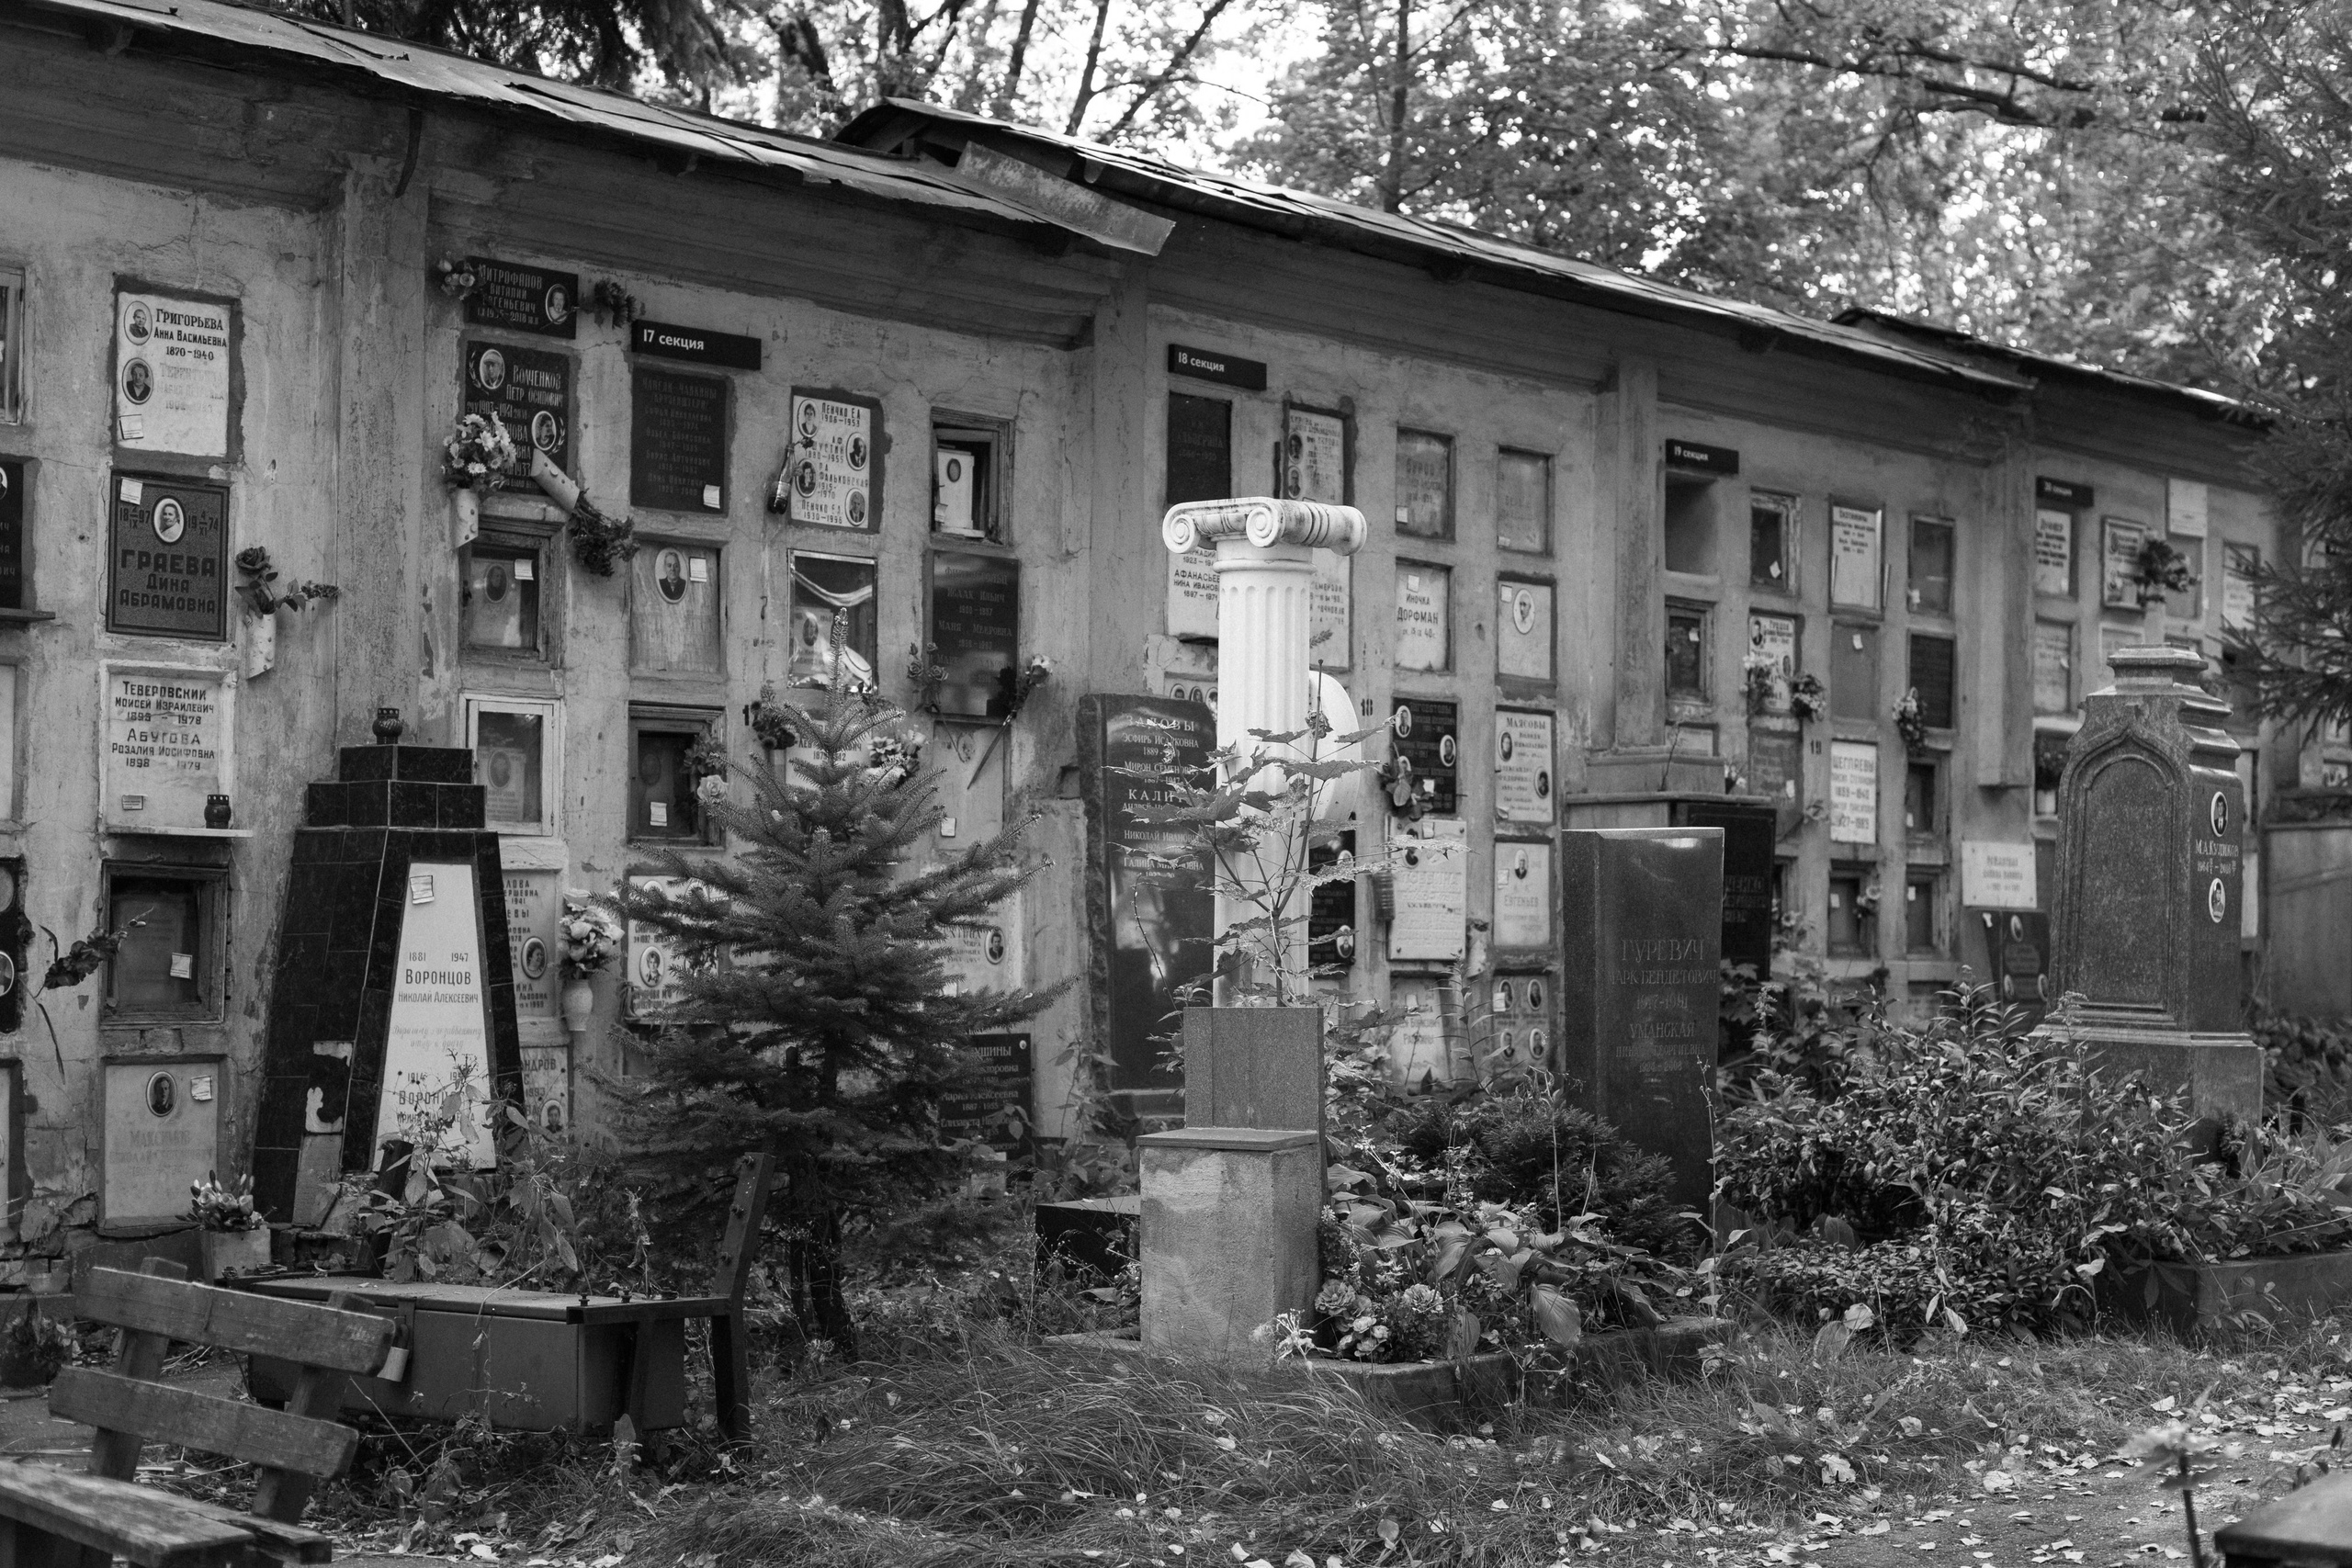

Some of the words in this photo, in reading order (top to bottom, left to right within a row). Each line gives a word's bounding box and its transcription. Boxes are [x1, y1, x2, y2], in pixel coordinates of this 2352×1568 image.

[479, 265, 543, 290] МИТРОФАНОВ
[490, 282, 527, 299] ВИТАЛИЙ
[155, 309, 223, 331] ГРИГОРЬЕВА
[153, 327, 174, 341] АННА
[176, 330, 227, 347] ВАСИЛЬЕВНА
[644, 329, 655, 343] 17
[658, 334, 705, 350] секция
[1178, 352, 1188, 365] 18
[1190, 356, 1225, 372] секция
[513, 365, 561, 390] ВОЛЧЕНКОВ
[506, 384, 525, 401] ПЕТР
[121, 548, 216, 577] ГРАЕВА
[147, 573, 189, 593] ДИНА
[1173, 579, 1191, 588] НИНА
[119, 589, 215, 614] АБРАМОВНА
[1406, 593, 1430, 605] ИНОЧКА
[1396, 606, 1439, 625] ДОРФМАН
[115, 696, 152, 710] МОИСЕЙ
[155, 699, 214, 714] ИЗРАИЛЕВИЧ
[1361, 698, 1374, 716] 18
[127, 728, 200, 745] АБУГОВА
[1122, 733, 1152, 744] ЭСФИРЬ
[111, 742, 155, 756] РОЗАЛИЯ
[159, 746, 215, 760] ИОСИФОВНА
[126, 758, 150, 768] 1898
[1124, 829, 1159, 841] НИКОЛАЙ
[409, 952, 426, 962] 1881
[451, 953, 469, 962] 1947
[1620, 939, 1704, 963] ГУРЕВИЧ
[405, 969, 471, 987] ВОРОНЦОВ
[398, 989, 433, 1003] НИКОЛАЙ
[434, 991, 479, 1003] АЛЕКСЕЕВИЧ
[1629, 1021, 1695, 1039] УМАНСКАЯ
